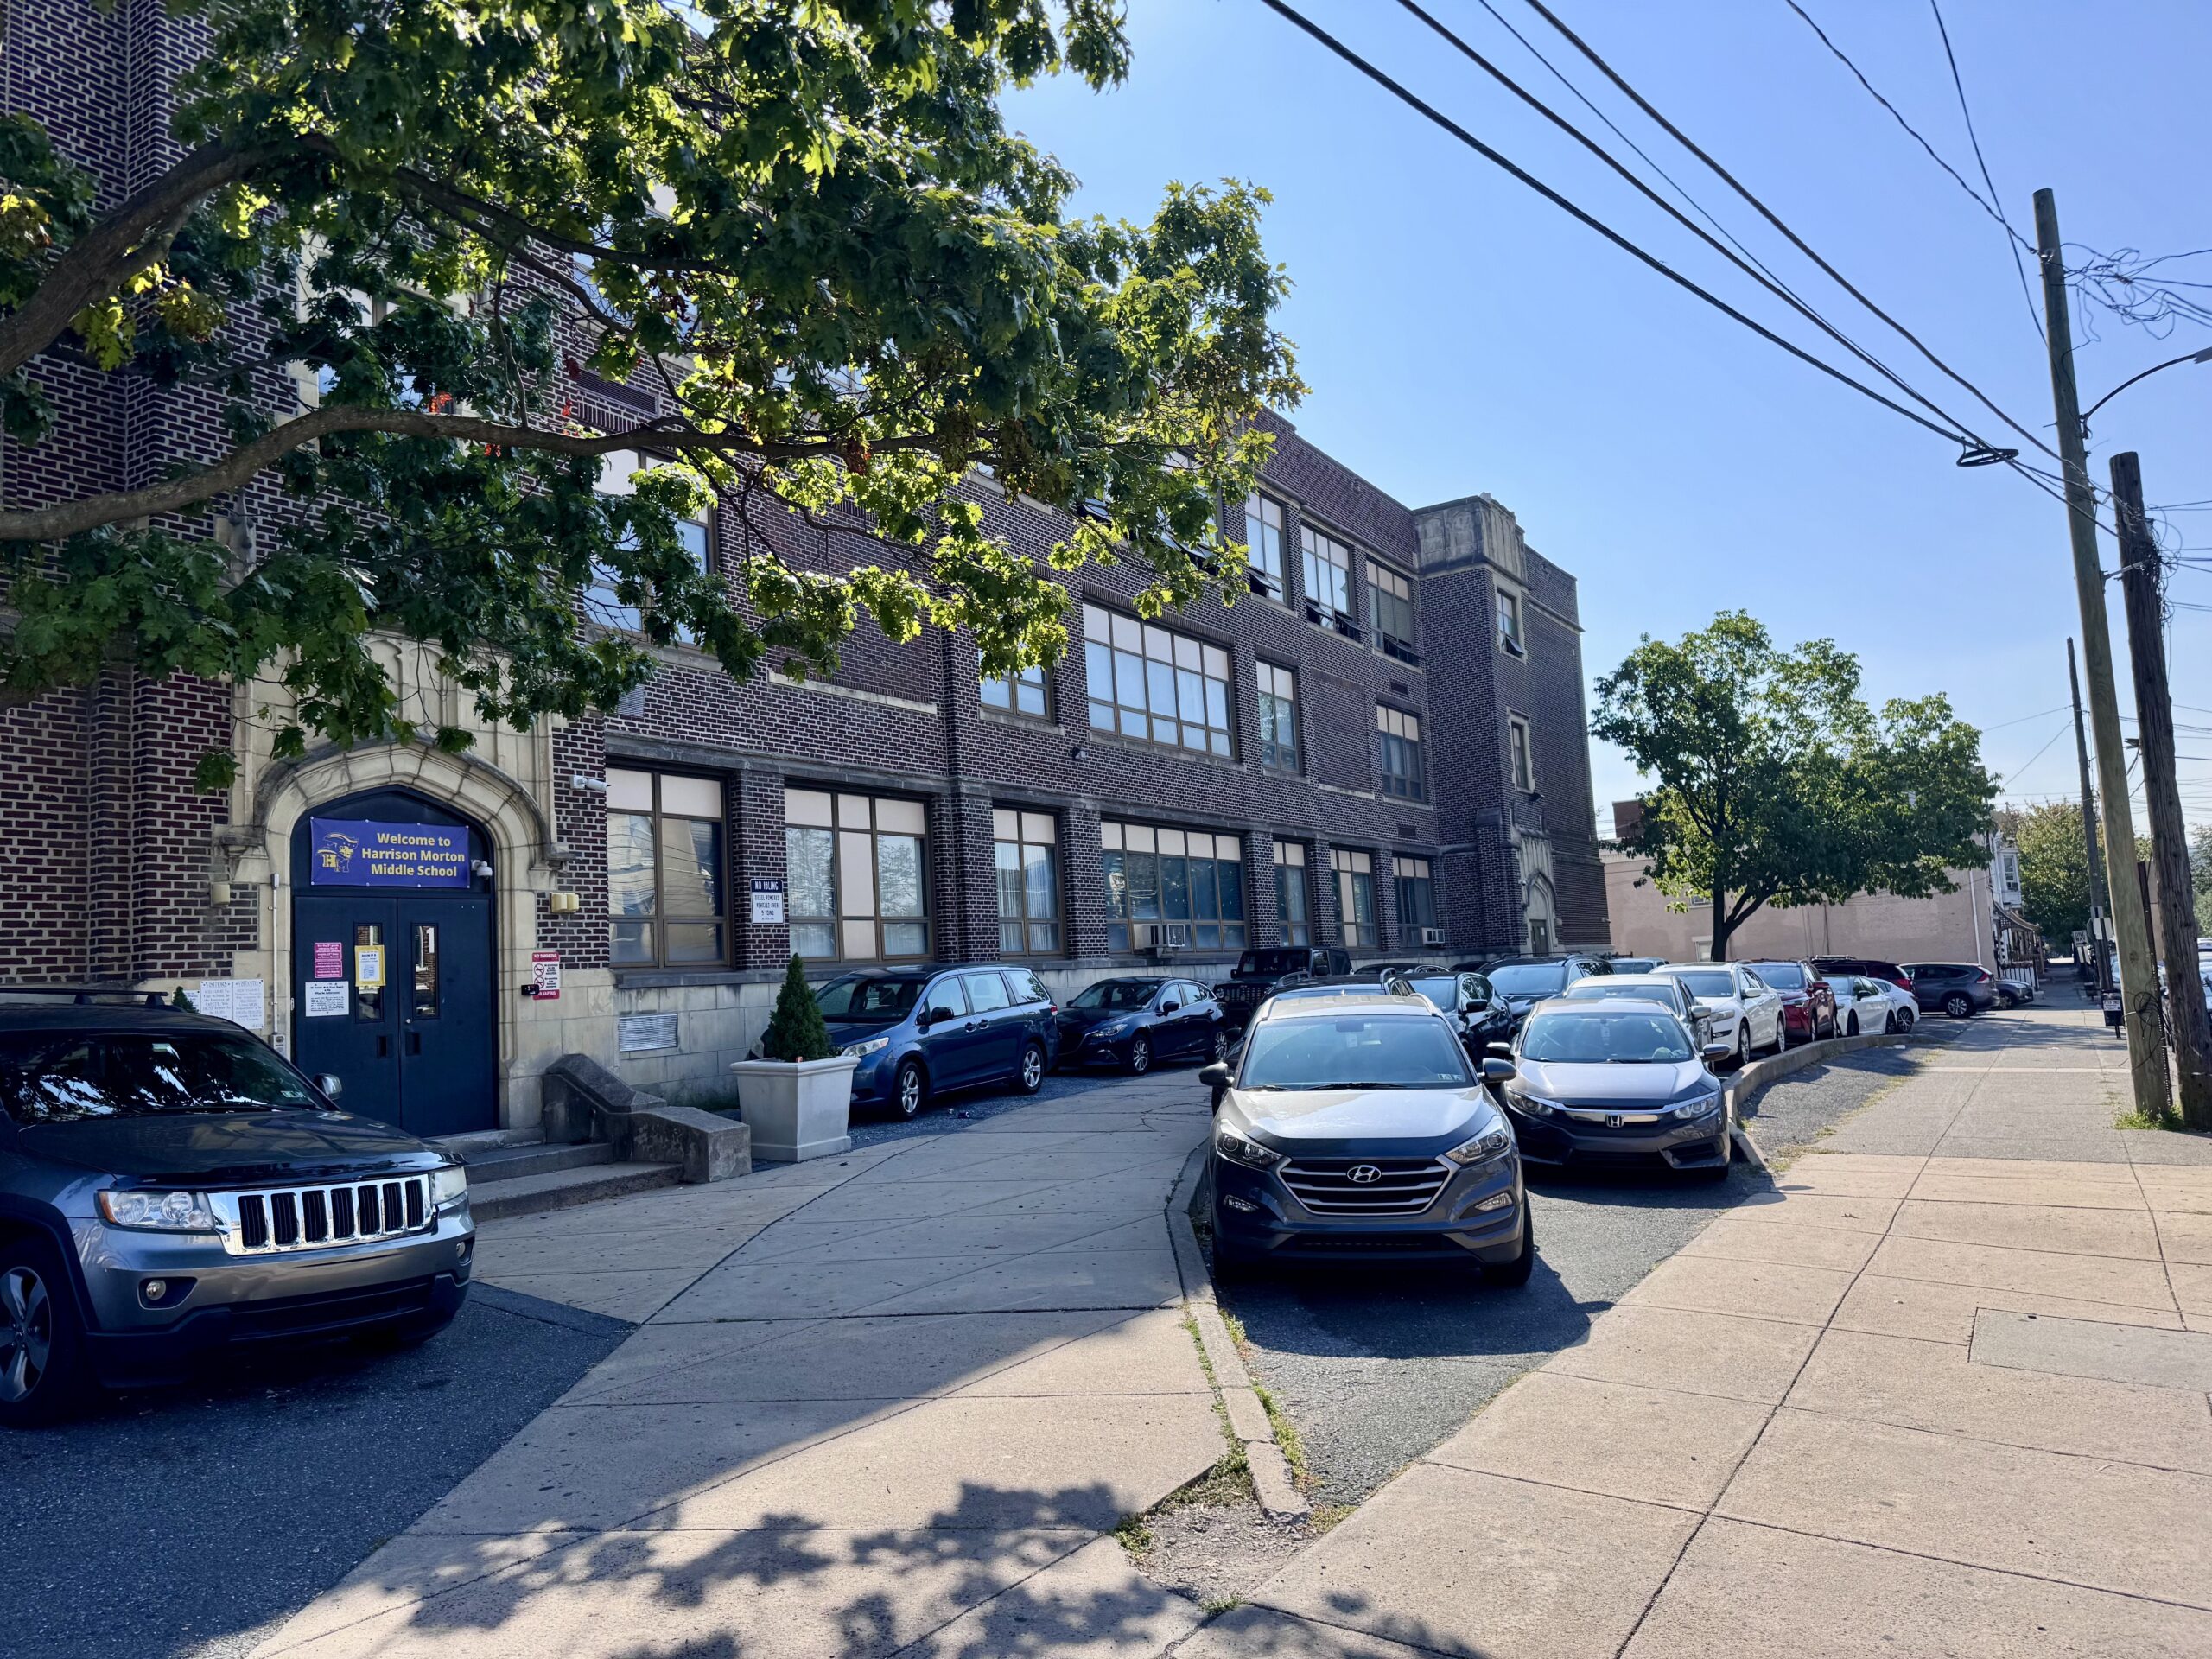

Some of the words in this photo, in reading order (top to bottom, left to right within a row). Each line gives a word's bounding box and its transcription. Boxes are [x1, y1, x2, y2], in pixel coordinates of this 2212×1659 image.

[377, 832, 435, 846] Welcome
[438, 836, 451, 847] to
[361, 848, 416, 861] Harrison
[420, 850, 465, 862] Morton
[371, 864, 415, 875] Middle
[417, 866, 457, 877] School
[754, 880, 762, 890] NO
[763, 881, 778, 890] IDLING
